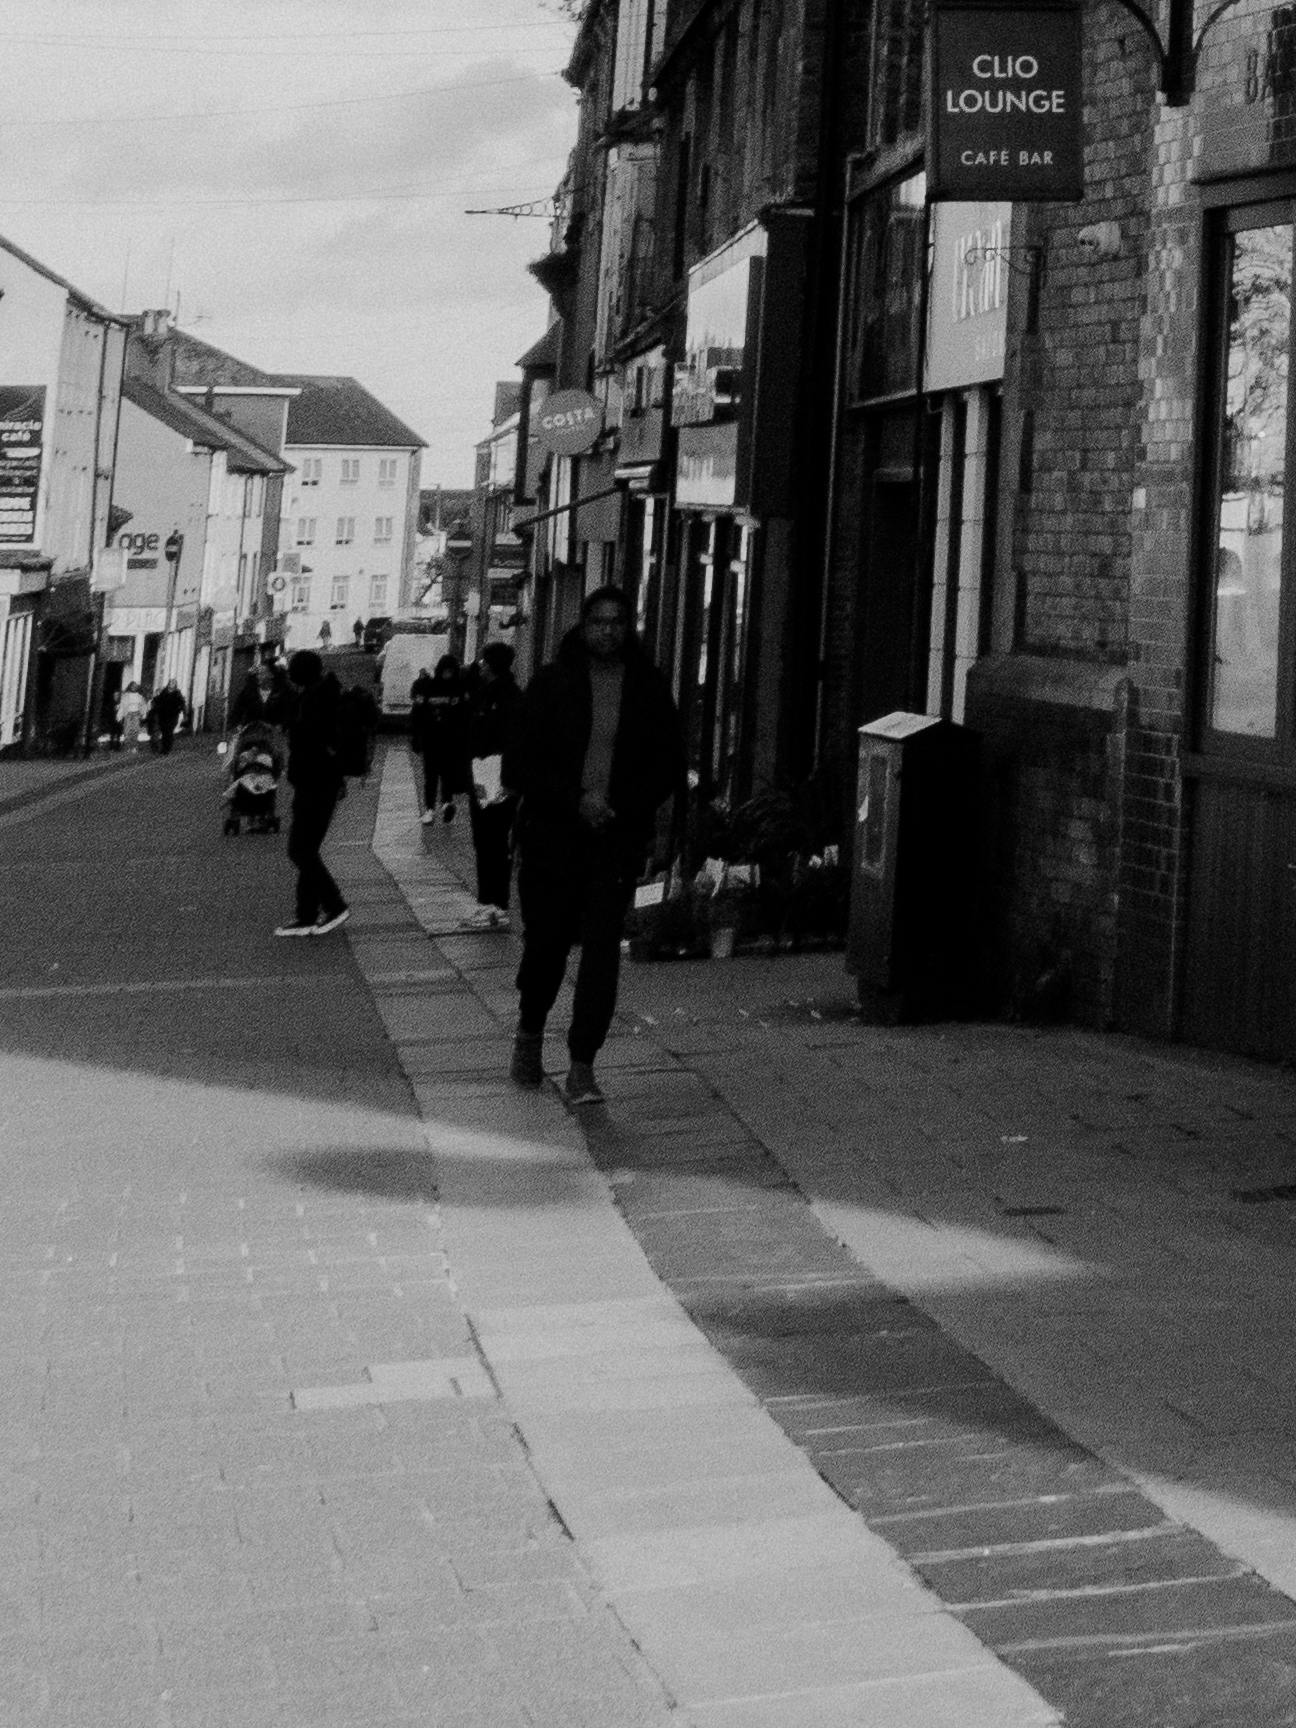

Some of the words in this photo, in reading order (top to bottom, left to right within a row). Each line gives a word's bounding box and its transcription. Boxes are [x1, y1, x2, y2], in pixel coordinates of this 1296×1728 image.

[972, 54, 1039, 79] CLIO
[946, 89, 1066, 113] LOUNGE
[1019, 150, 1053, 166] BAR
[541, 406, 596, 430] COSTA
